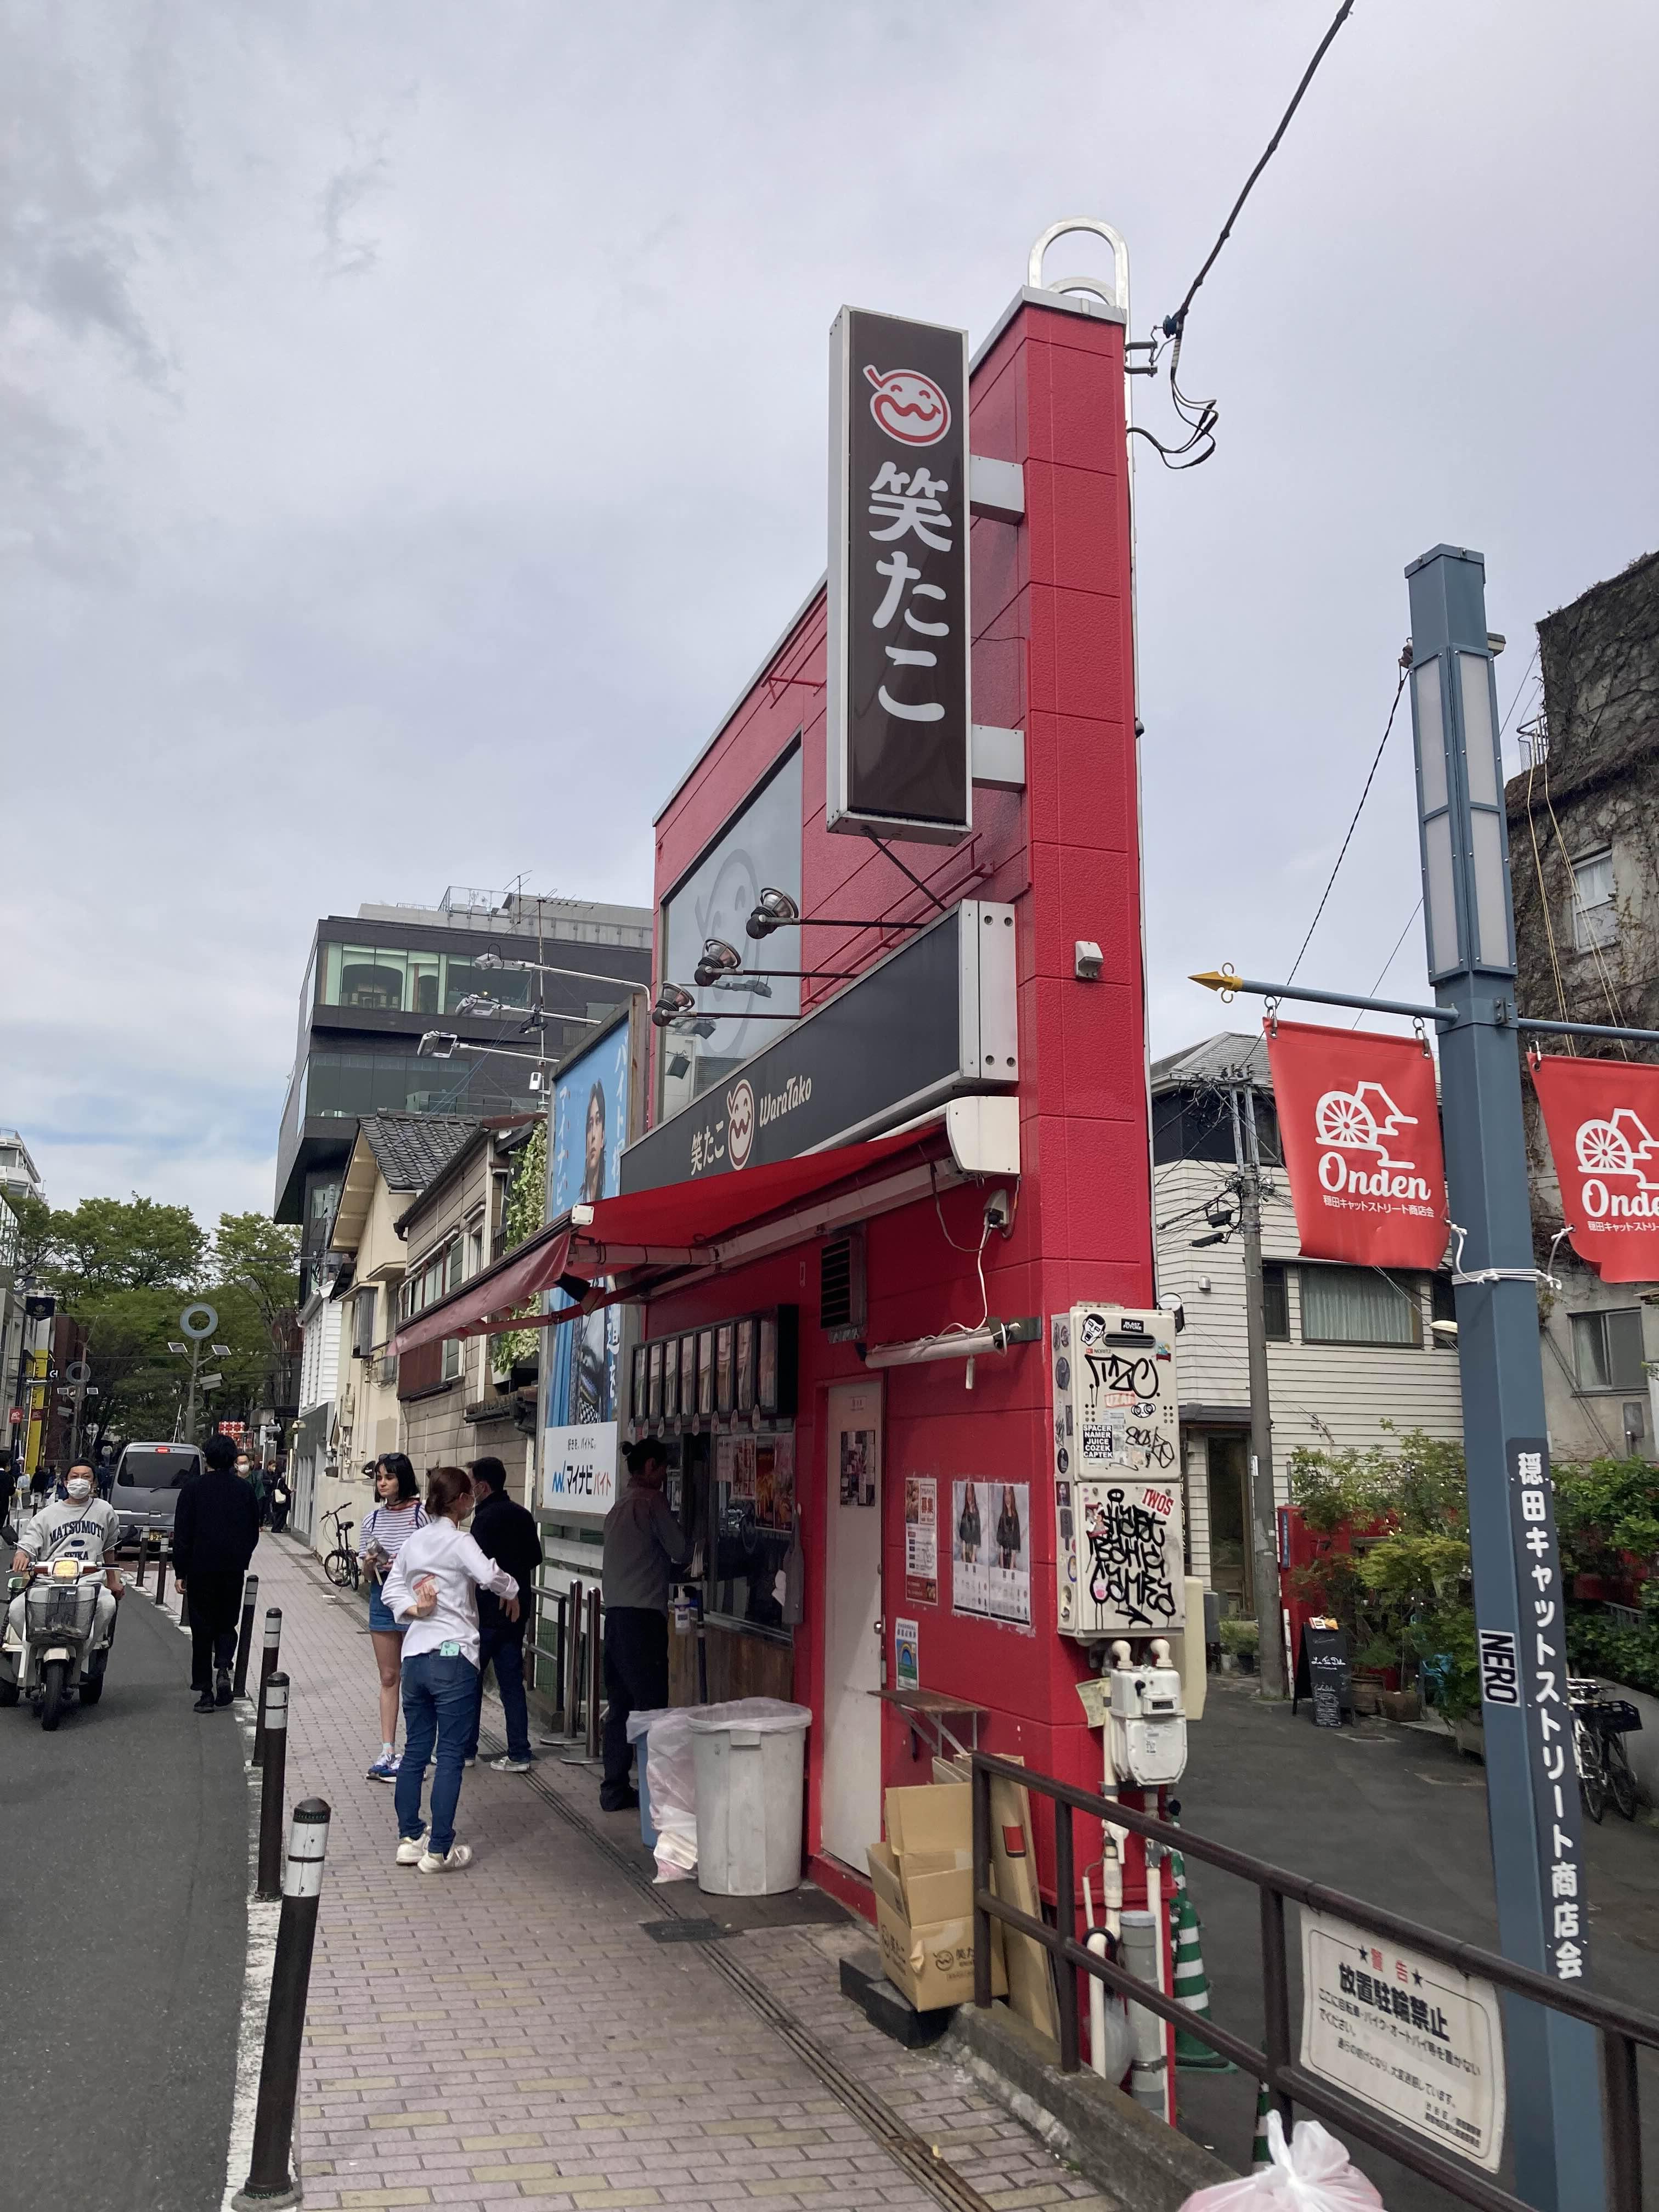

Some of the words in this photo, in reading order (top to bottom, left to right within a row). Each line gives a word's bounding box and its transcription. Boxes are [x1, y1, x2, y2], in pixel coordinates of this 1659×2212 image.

[868, 460, 953, 721] 笑たこ
[759, 1075, 812, 1127] WaraTako
[556, 1086, 568, 1210] マイナビ
[691, 1121, 724, 1175] 笑たこ
[1318, 1152, 1431, 1200] Onden
[49, 1520, 104, 1546] MATSUMOTO
[1481, 1633, 1518, 1704] NERO
[1518, 1452, 1582, 1979] 穏田キャットストリート商店会
